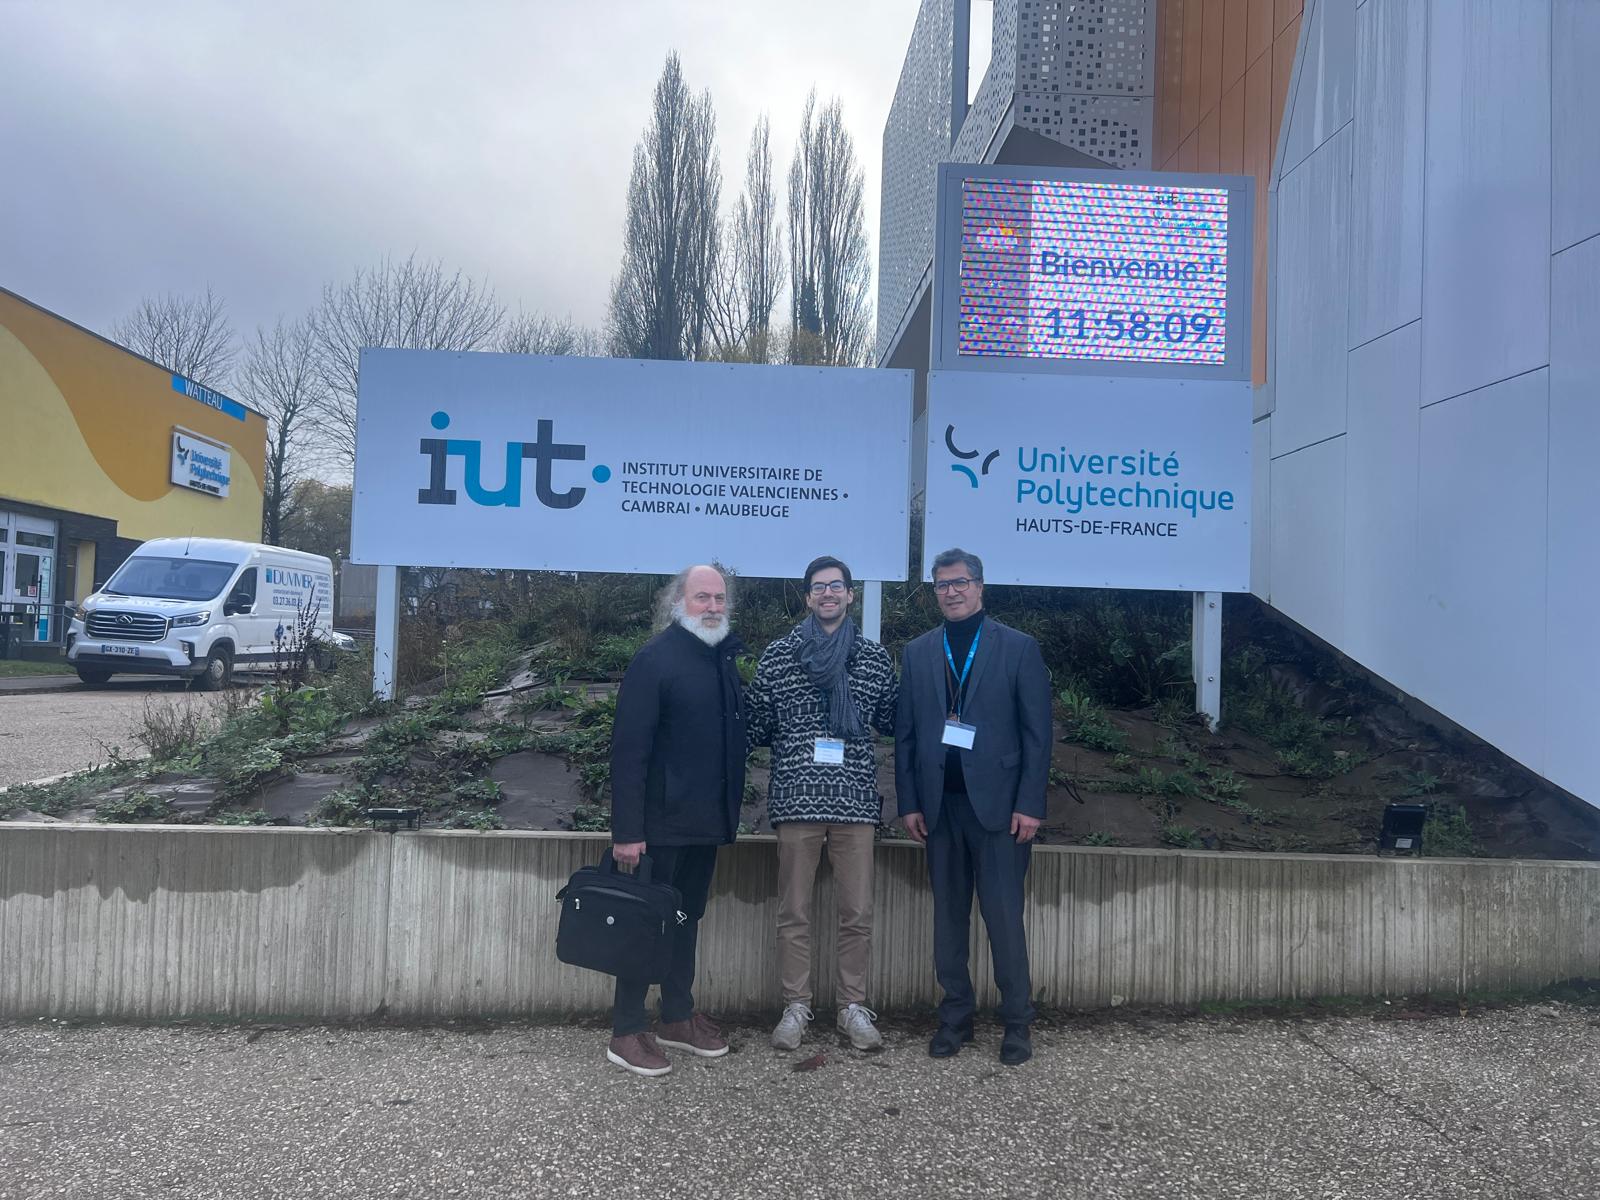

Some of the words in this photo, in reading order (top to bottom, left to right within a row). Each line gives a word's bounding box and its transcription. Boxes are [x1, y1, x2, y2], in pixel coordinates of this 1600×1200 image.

[1041, 251, 1198, 281] Bienvenue
[185, 379, 223, 410] WATTEAU
[622, 462, 688, 477] INSTITUT
[692, 465, 800, 481] UNIVERSITAIRE
[804, 469, 823, 481] DE
[1018, 446, 1179, 477] Université
[622, 481, 726, 497] TECHNOLOGIE
[730, 485, 839, 501] VALENCIENNES
[1016, 478, 1235, 518] Polytechnique
[621, 500, 690, 514] CAMBRAI
[705, 503, 790, 518] MAUBEUGE
[1016, 518, 1178, 537] HAUTS-DE-FRANCE
